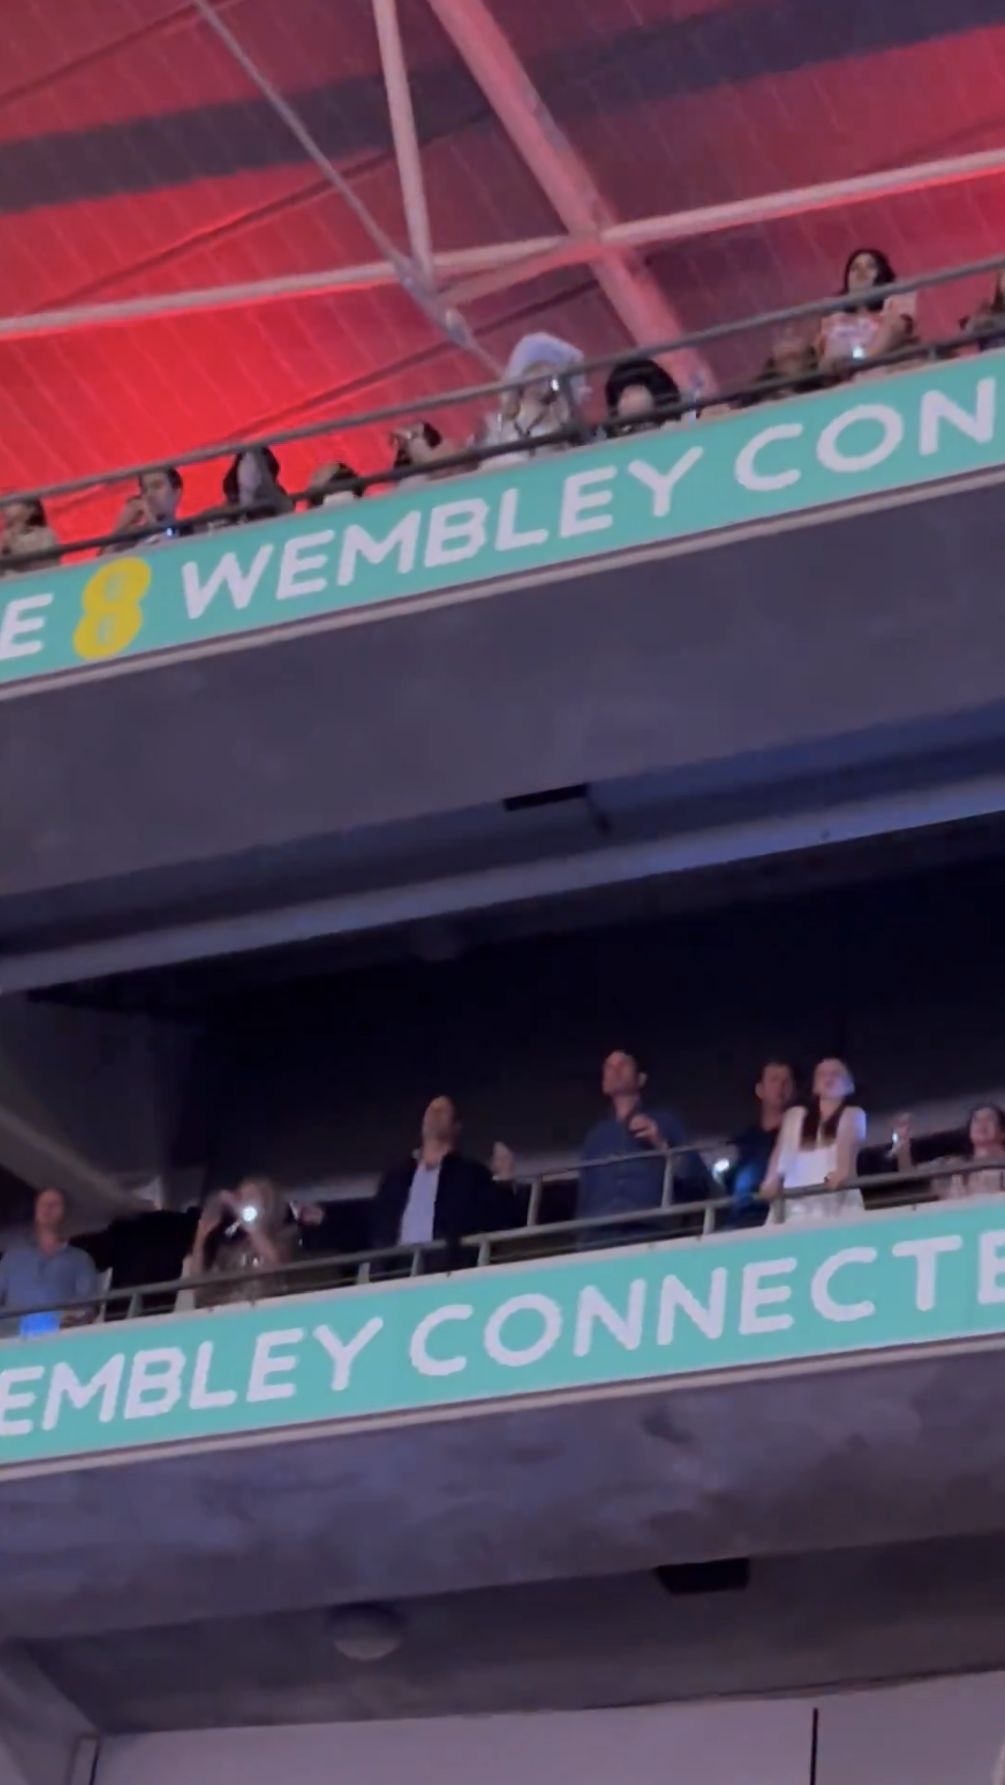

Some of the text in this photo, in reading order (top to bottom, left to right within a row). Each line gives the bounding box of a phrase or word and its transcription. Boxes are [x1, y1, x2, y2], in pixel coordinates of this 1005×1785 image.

[182, 446, 703, 619] WEMBLEY
[734, 377, 996, 491] CON
[0, 1317, 384, 1437] EMBLEY
